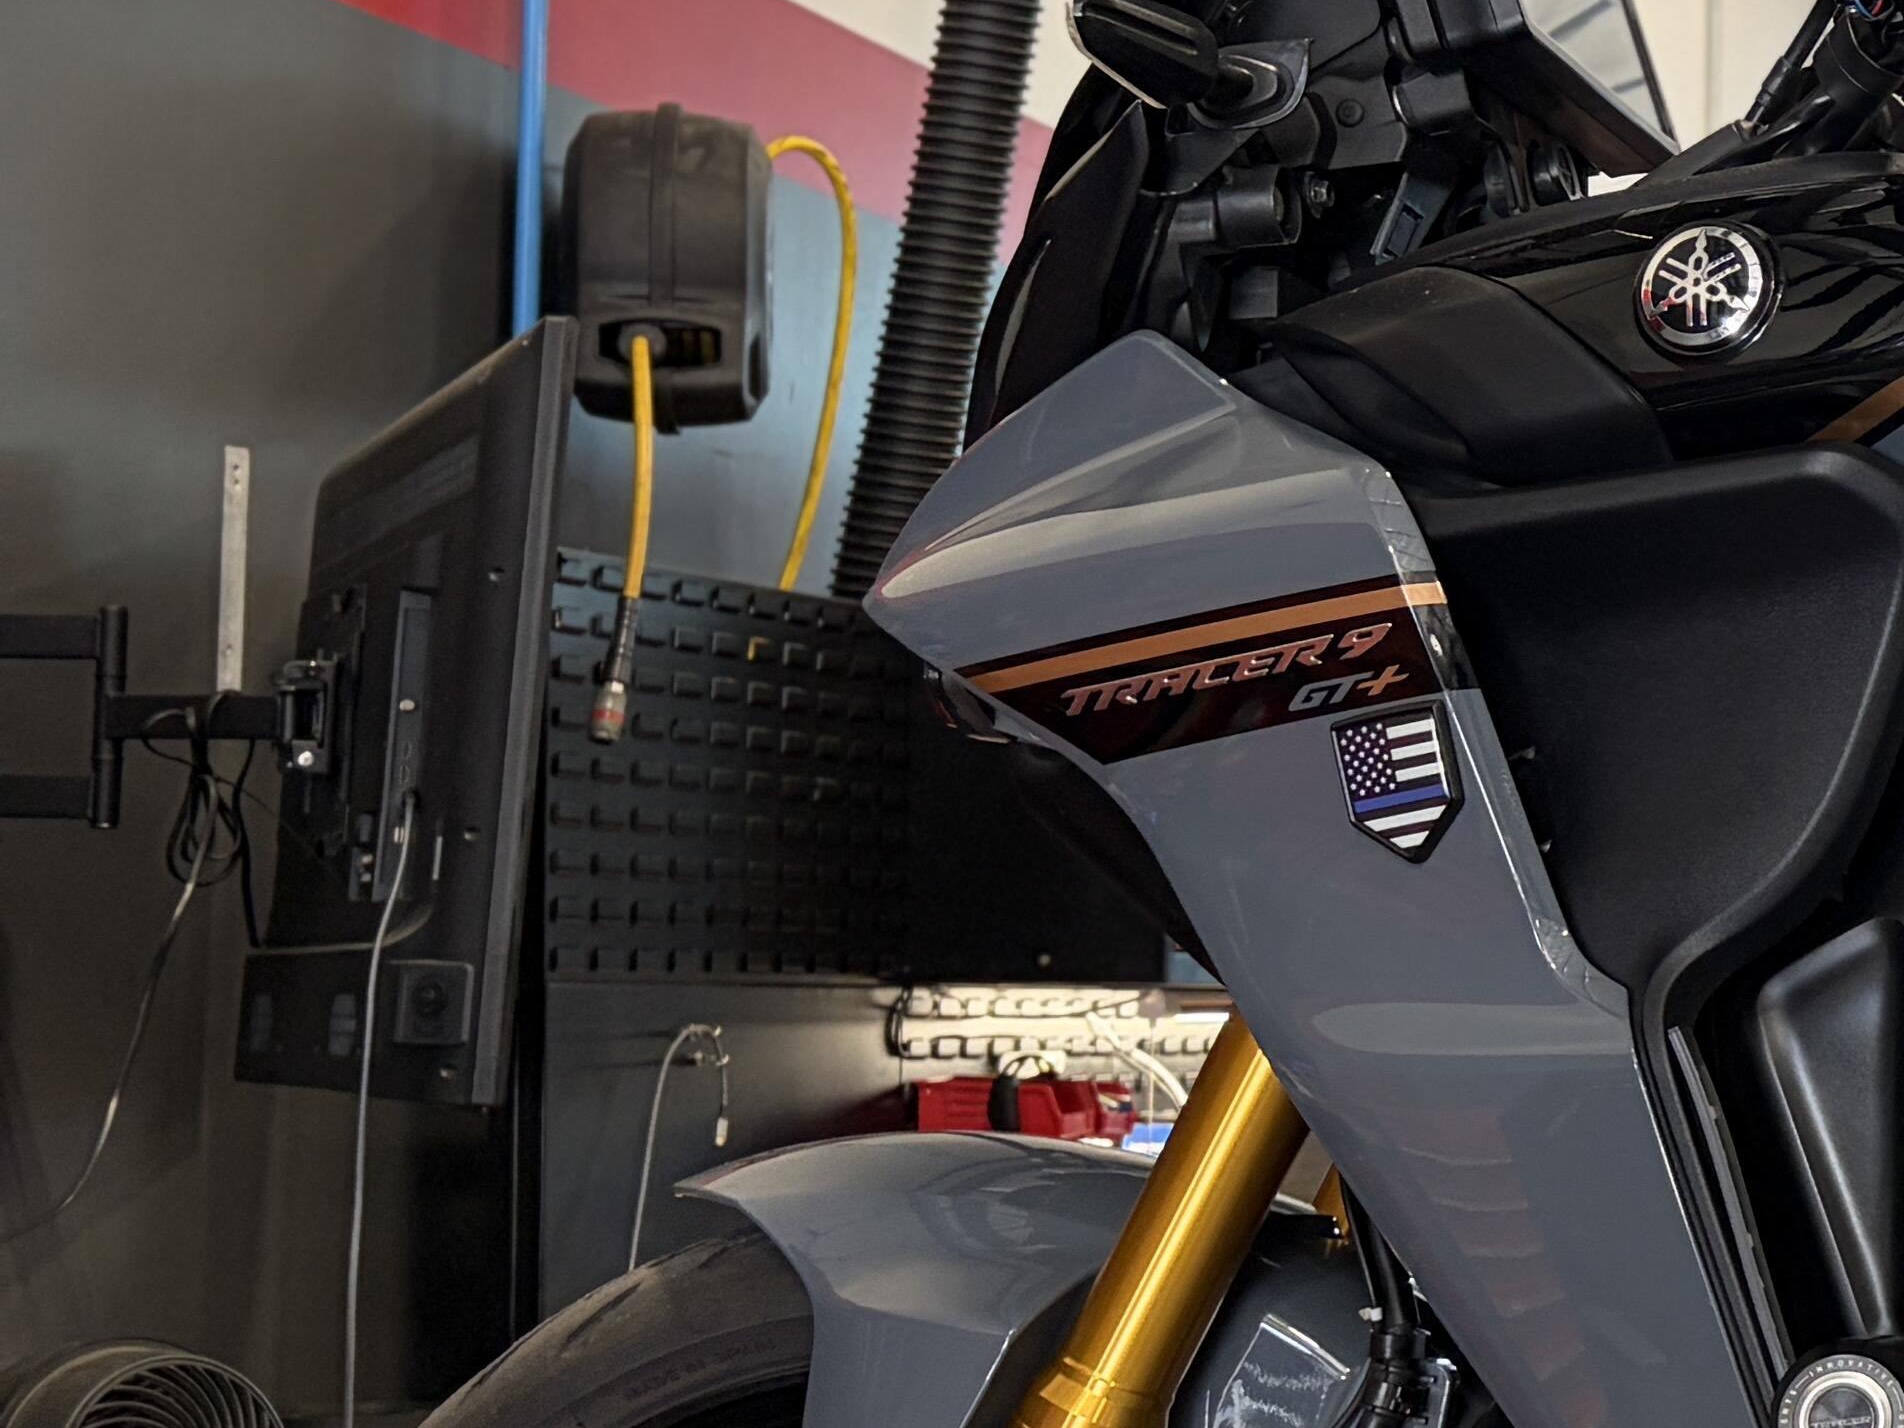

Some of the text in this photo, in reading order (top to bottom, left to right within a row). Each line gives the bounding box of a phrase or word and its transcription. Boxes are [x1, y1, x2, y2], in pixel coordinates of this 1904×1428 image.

[1060, 622, 1393, 717] TRACER 9
[1288, 664, 1410, 713] GT+
